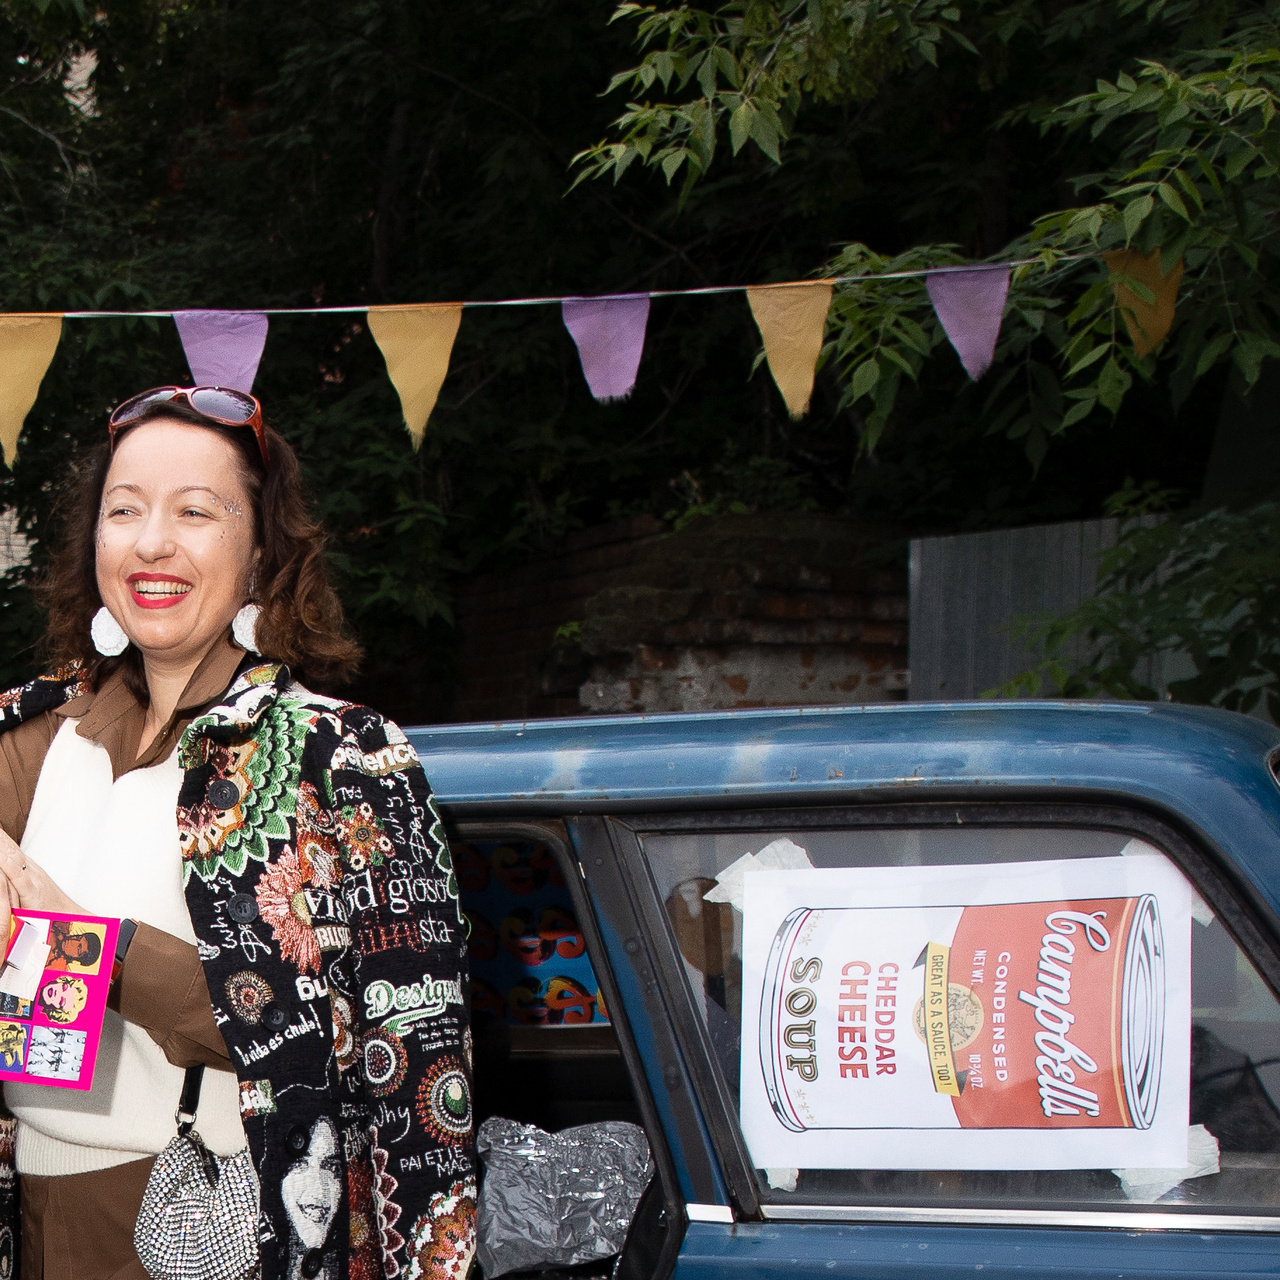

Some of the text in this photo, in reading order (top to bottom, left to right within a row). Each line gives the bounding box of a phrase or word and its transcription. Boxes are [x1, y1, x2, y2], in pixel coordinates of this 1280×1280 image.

[783, 956, 823, 1083] SOUP
[837, 960, 871, 1080] CHEESE
[874, 962, 899, 1077] CHEDDAR
[930, 954, 952, 1087] GREAT AS A SAUCE, TOO!
[972, 949, 987, 969] NET
[992, 951, 1011, 1082] CONDENSED
